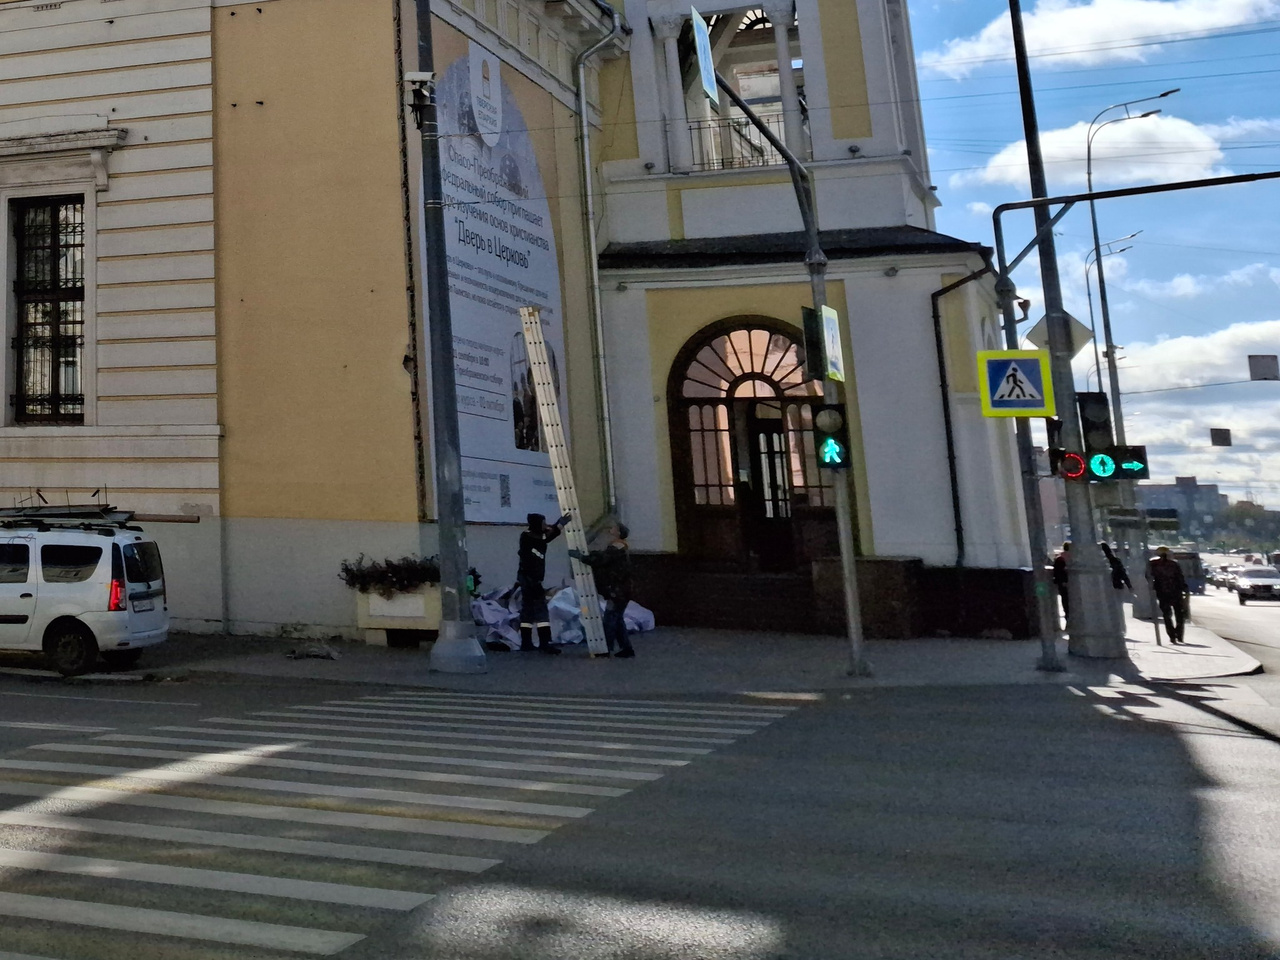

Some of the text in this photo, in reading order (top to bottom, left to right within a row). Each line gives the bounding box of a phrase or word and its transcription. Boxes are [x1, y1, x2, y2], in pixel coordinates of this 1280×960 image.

[441, 164, 486, 200] федральный
[487, 239, 493, 254] в
[489, 214, 509, 234] основ
[509, 223, 550, 252] христианства
